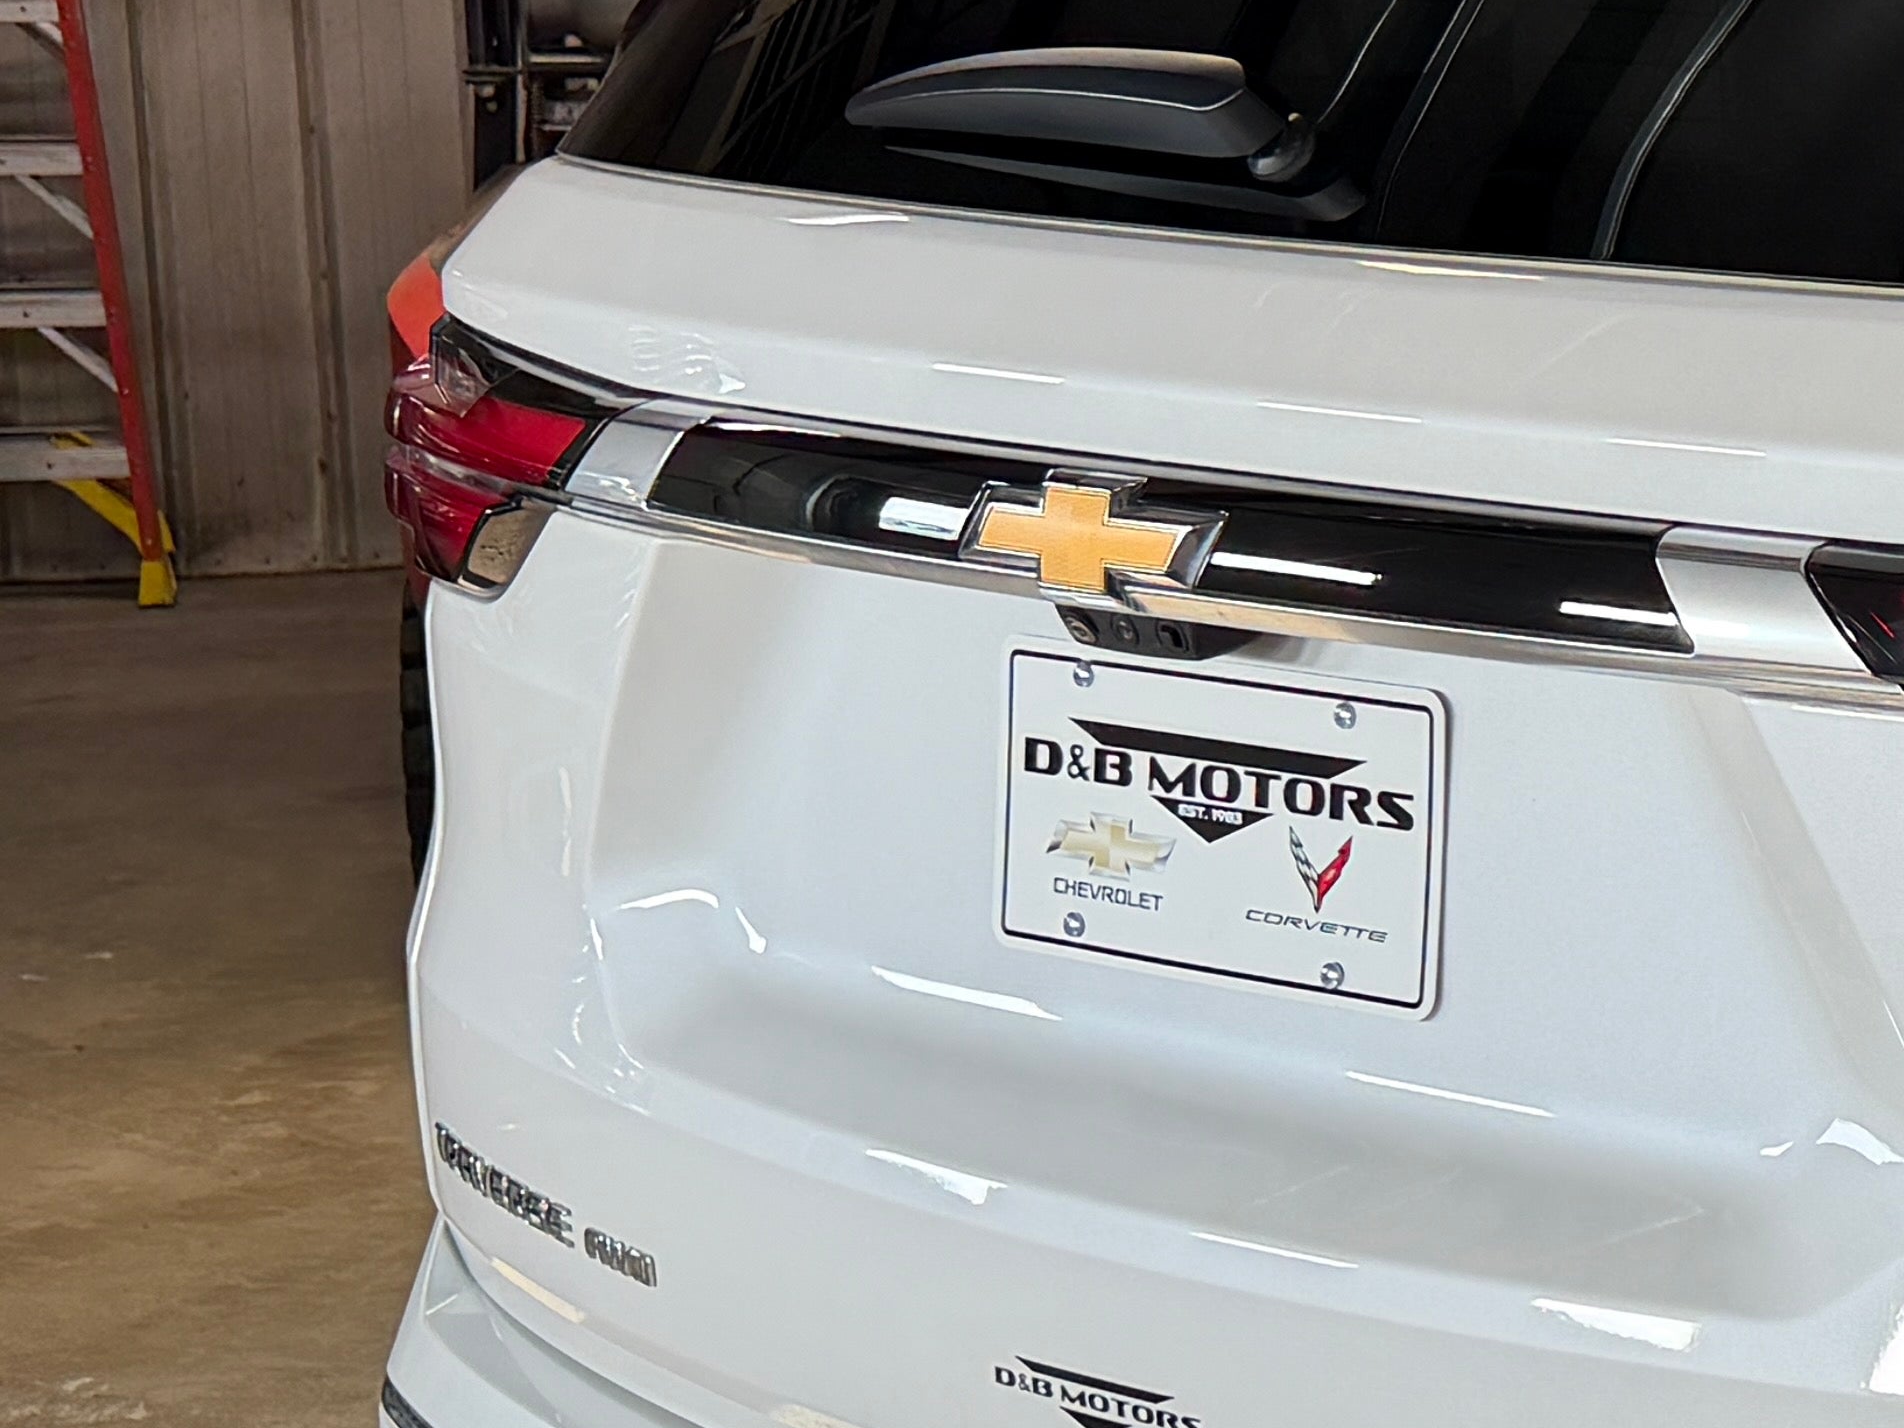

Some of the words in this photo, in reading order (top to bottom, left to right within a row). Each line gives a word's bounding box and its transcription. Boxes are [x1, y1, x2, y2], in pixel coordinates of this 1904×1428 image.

[1024, 737, 1132, 787] D&B
[1147, 756, 1414, 832] MOTORS
[1178, 803, 1209, 820] EST.
[1053, 877, 1164, 911] CHEVROLET
[1246, 910, 1388, 943] CORVETTE
[994, 1366, 1054, 1398] D&B
